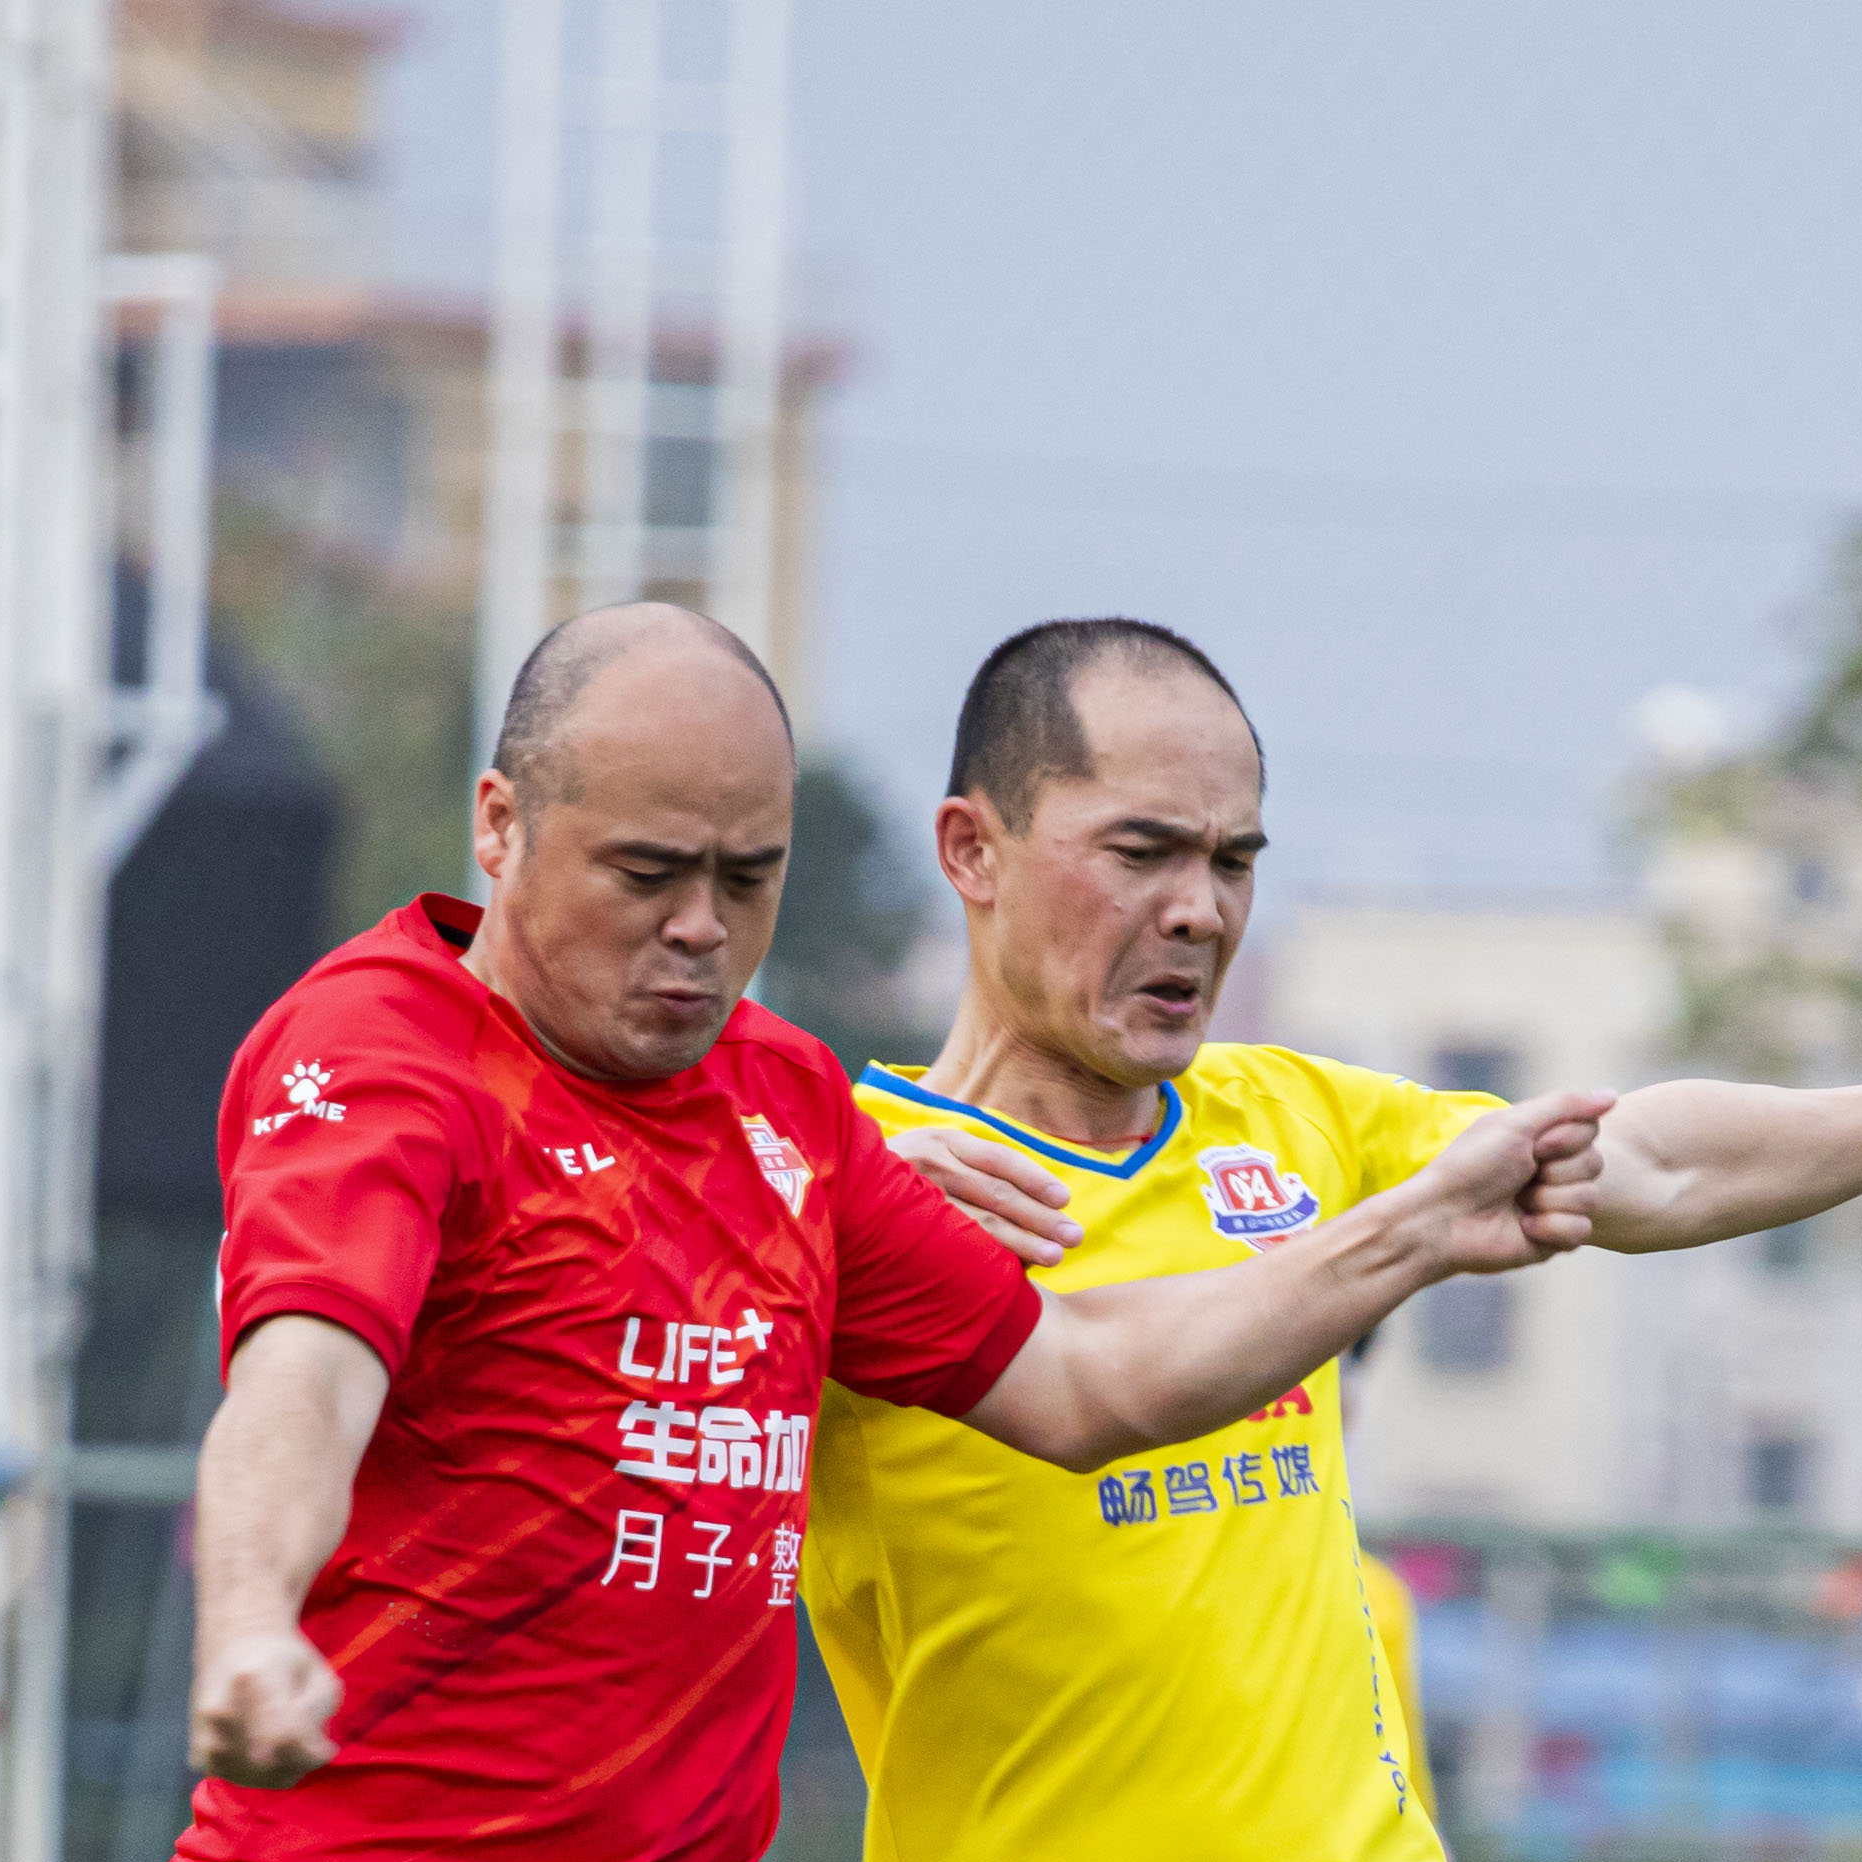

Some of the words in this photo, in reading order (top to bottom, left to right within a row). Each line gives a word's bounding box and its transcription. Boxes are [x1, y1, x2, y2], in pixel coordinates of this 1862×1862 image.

[253, 1100, 347, 1136] KEME
[1098, 1443, 1321, 1526] 畅驾传媒
